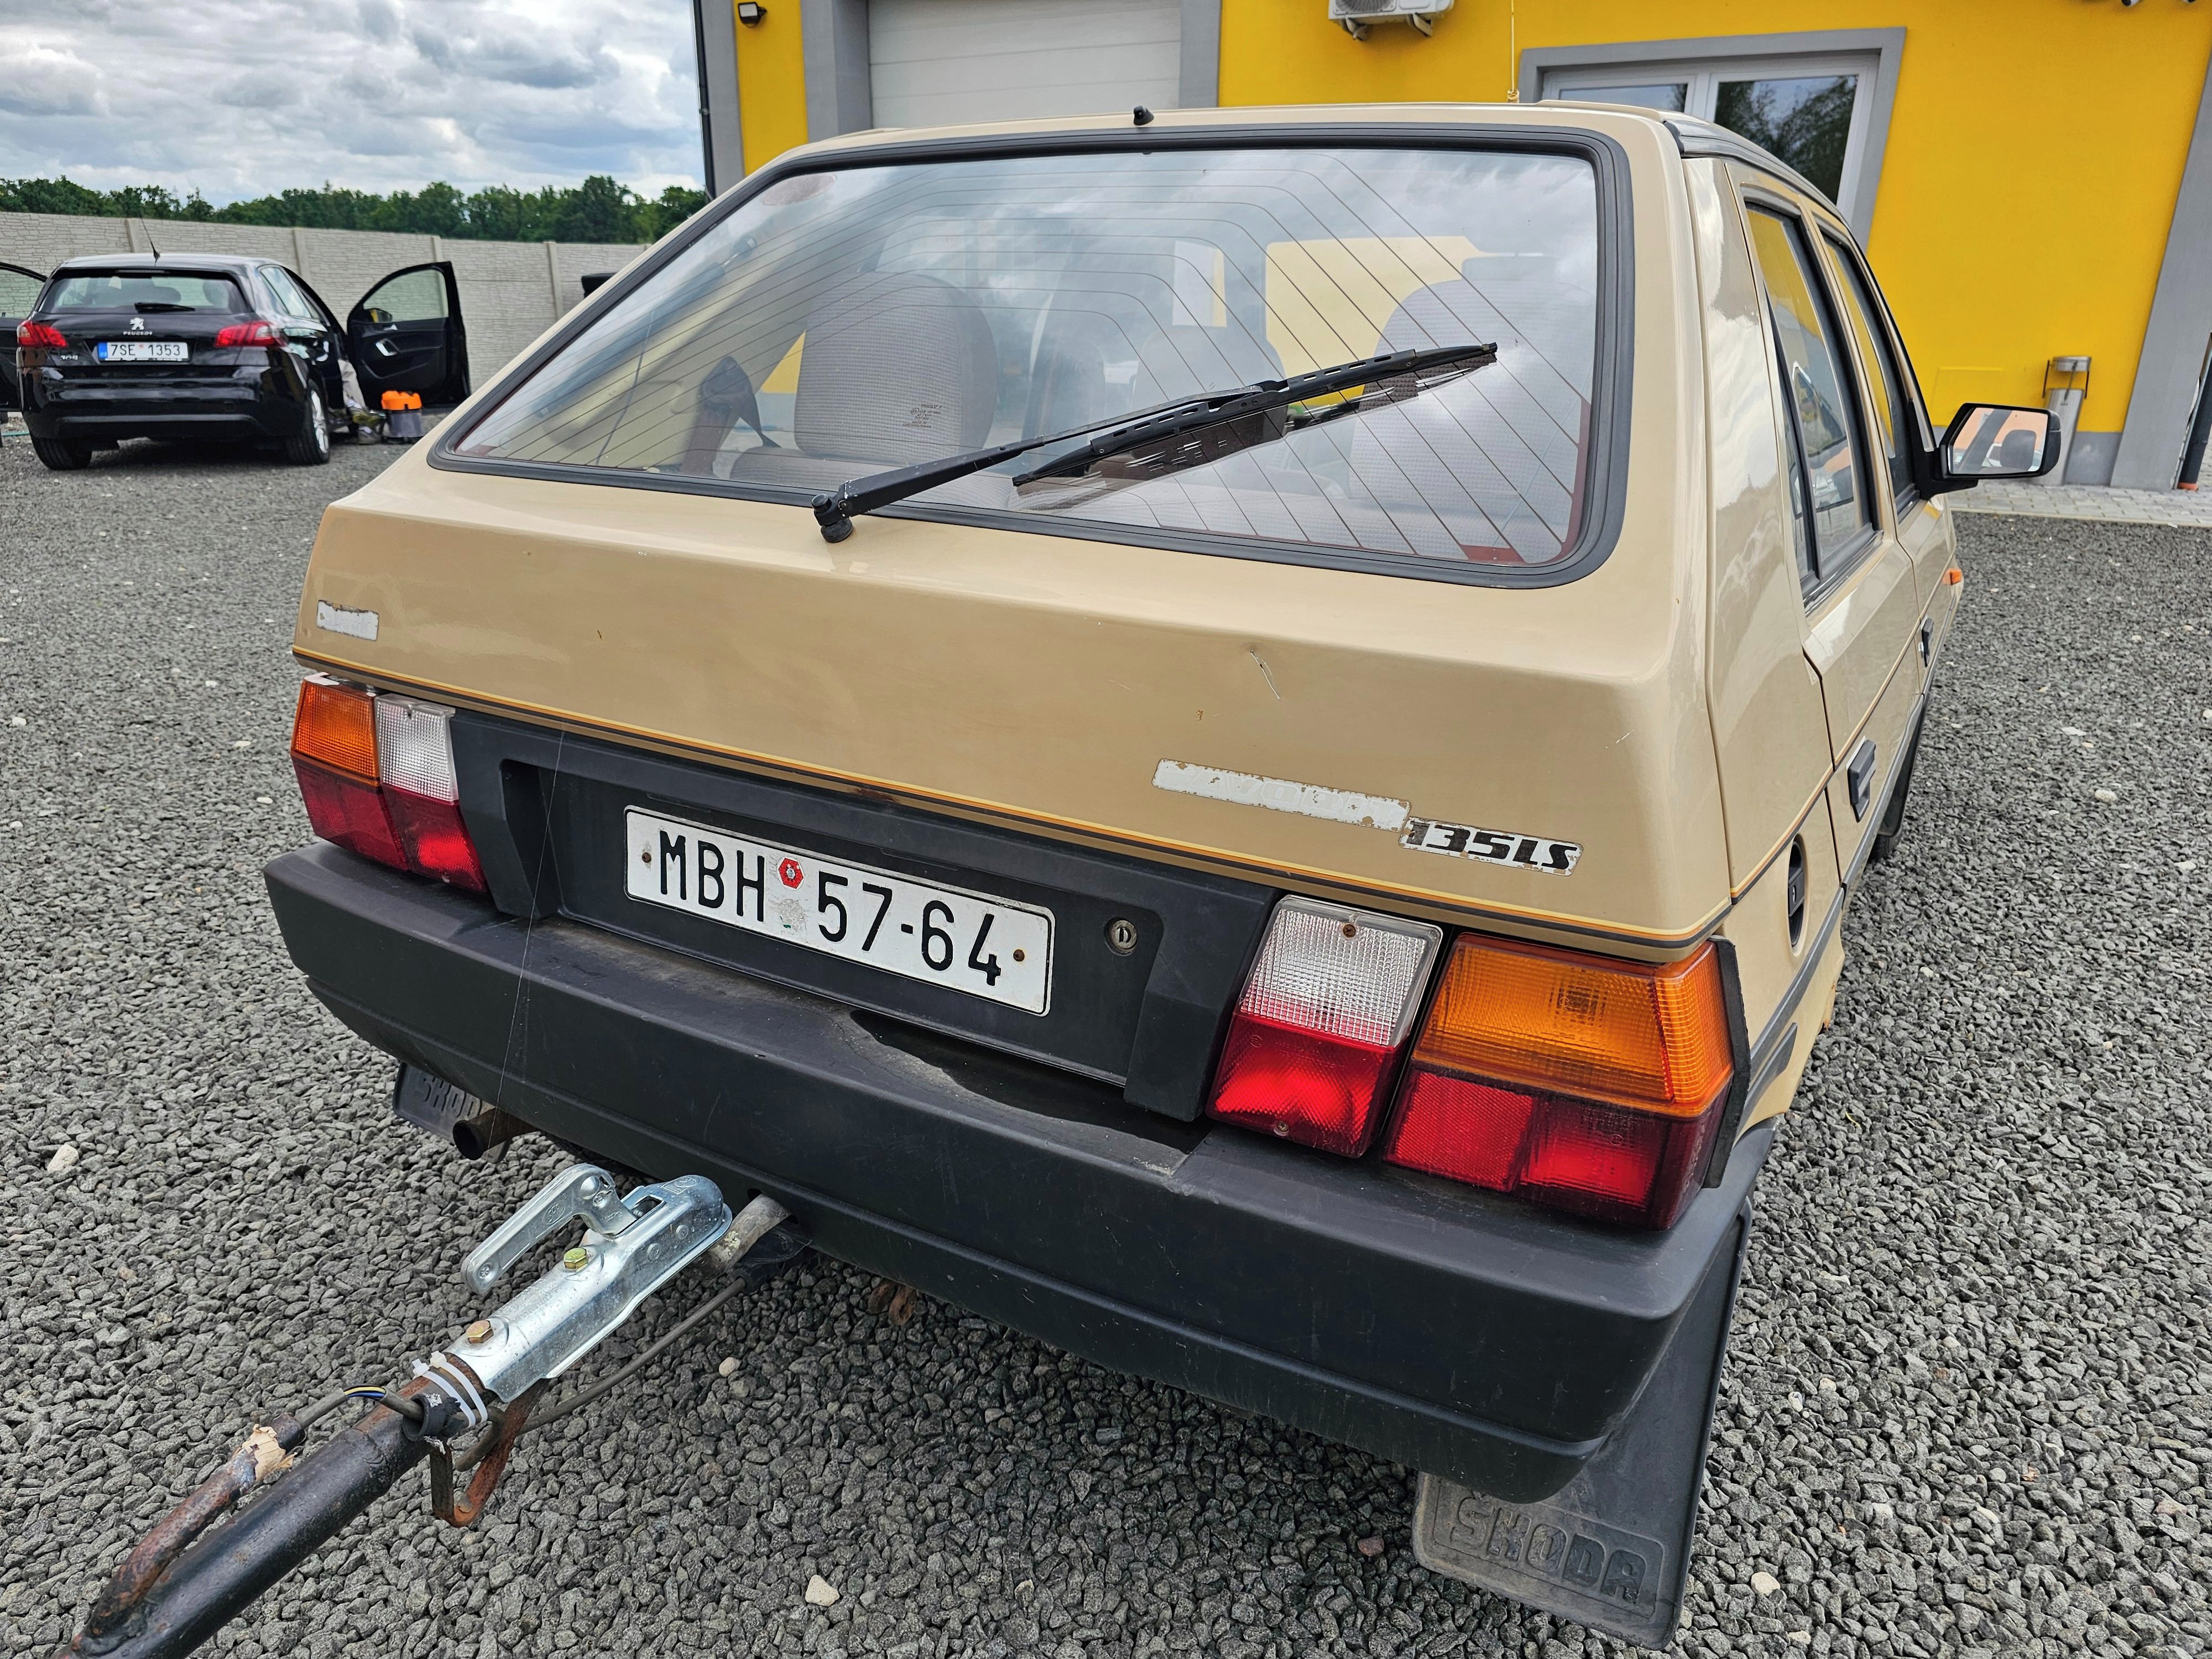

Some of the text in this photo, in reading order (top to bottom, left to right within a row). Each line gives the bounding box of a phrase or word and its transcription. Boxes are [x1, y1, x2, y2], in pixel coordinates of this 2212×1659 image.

[111, 344, 135, 356] 7SE
[148, 344, 181, 356] 1353
[659, 830, 1002, 987] MBH 57-64
